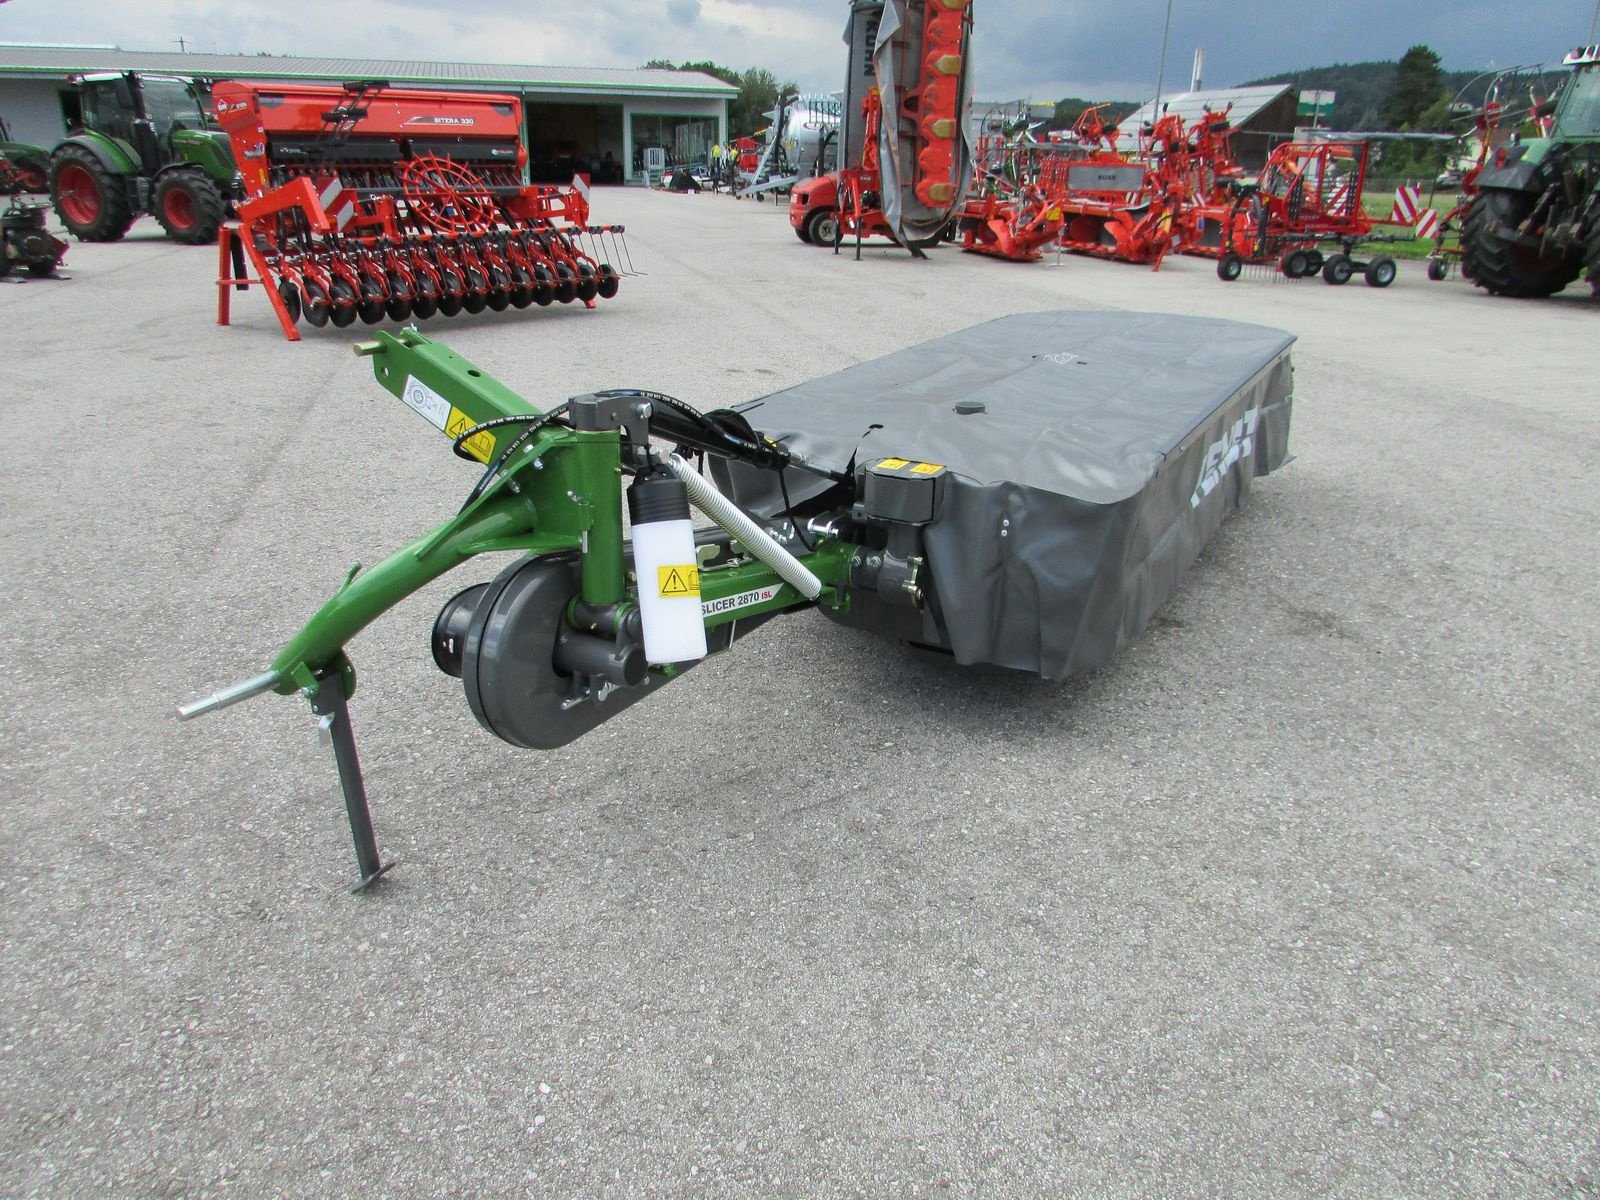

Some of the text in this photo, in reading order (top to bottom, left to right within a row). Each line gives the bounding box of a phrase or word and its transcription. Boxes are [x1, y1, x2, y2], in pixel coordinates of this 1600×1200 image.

[701, 590, 773, 615] SLICER 2870 ISL
